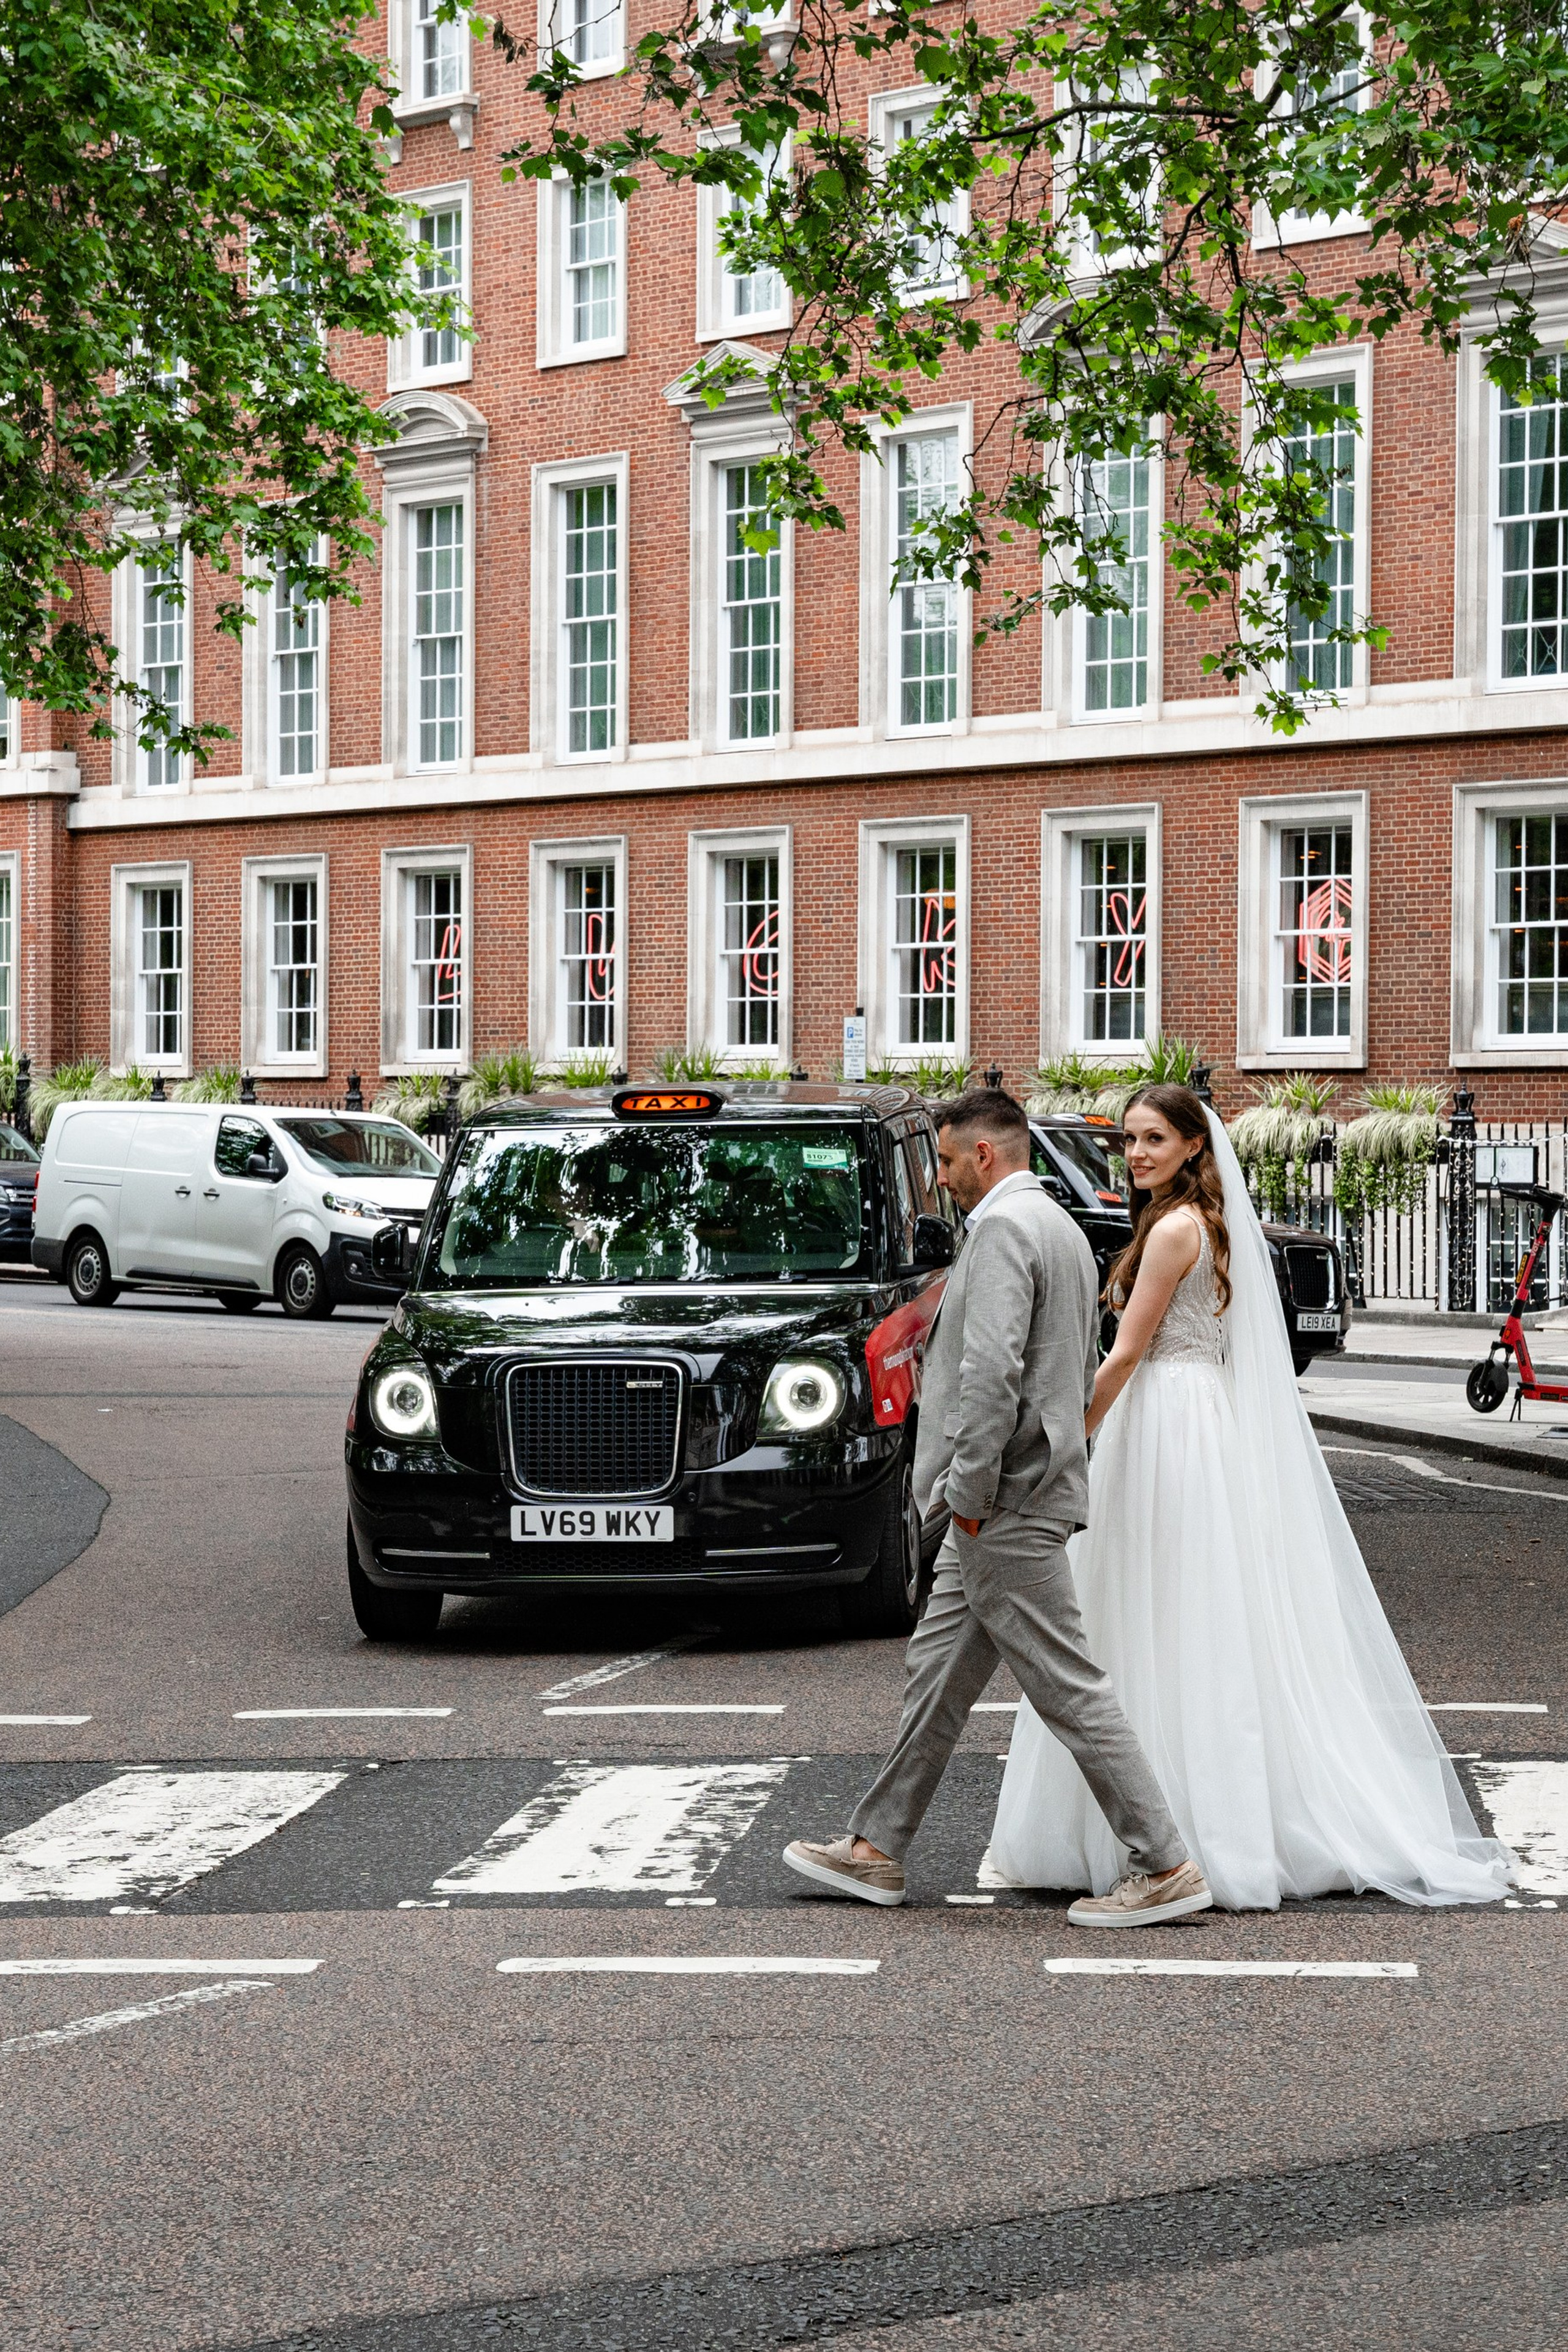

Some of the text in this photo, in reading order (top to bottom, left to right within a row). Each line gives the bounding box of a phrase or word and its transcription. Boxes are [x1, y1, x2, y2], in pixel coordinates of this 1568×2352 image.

[630, 1097, 701, 1109] TAXI
[1302, 1316, 1335, 1329] LE19 XEA
[521, 1510, 661, 1536] LV69 WKY
